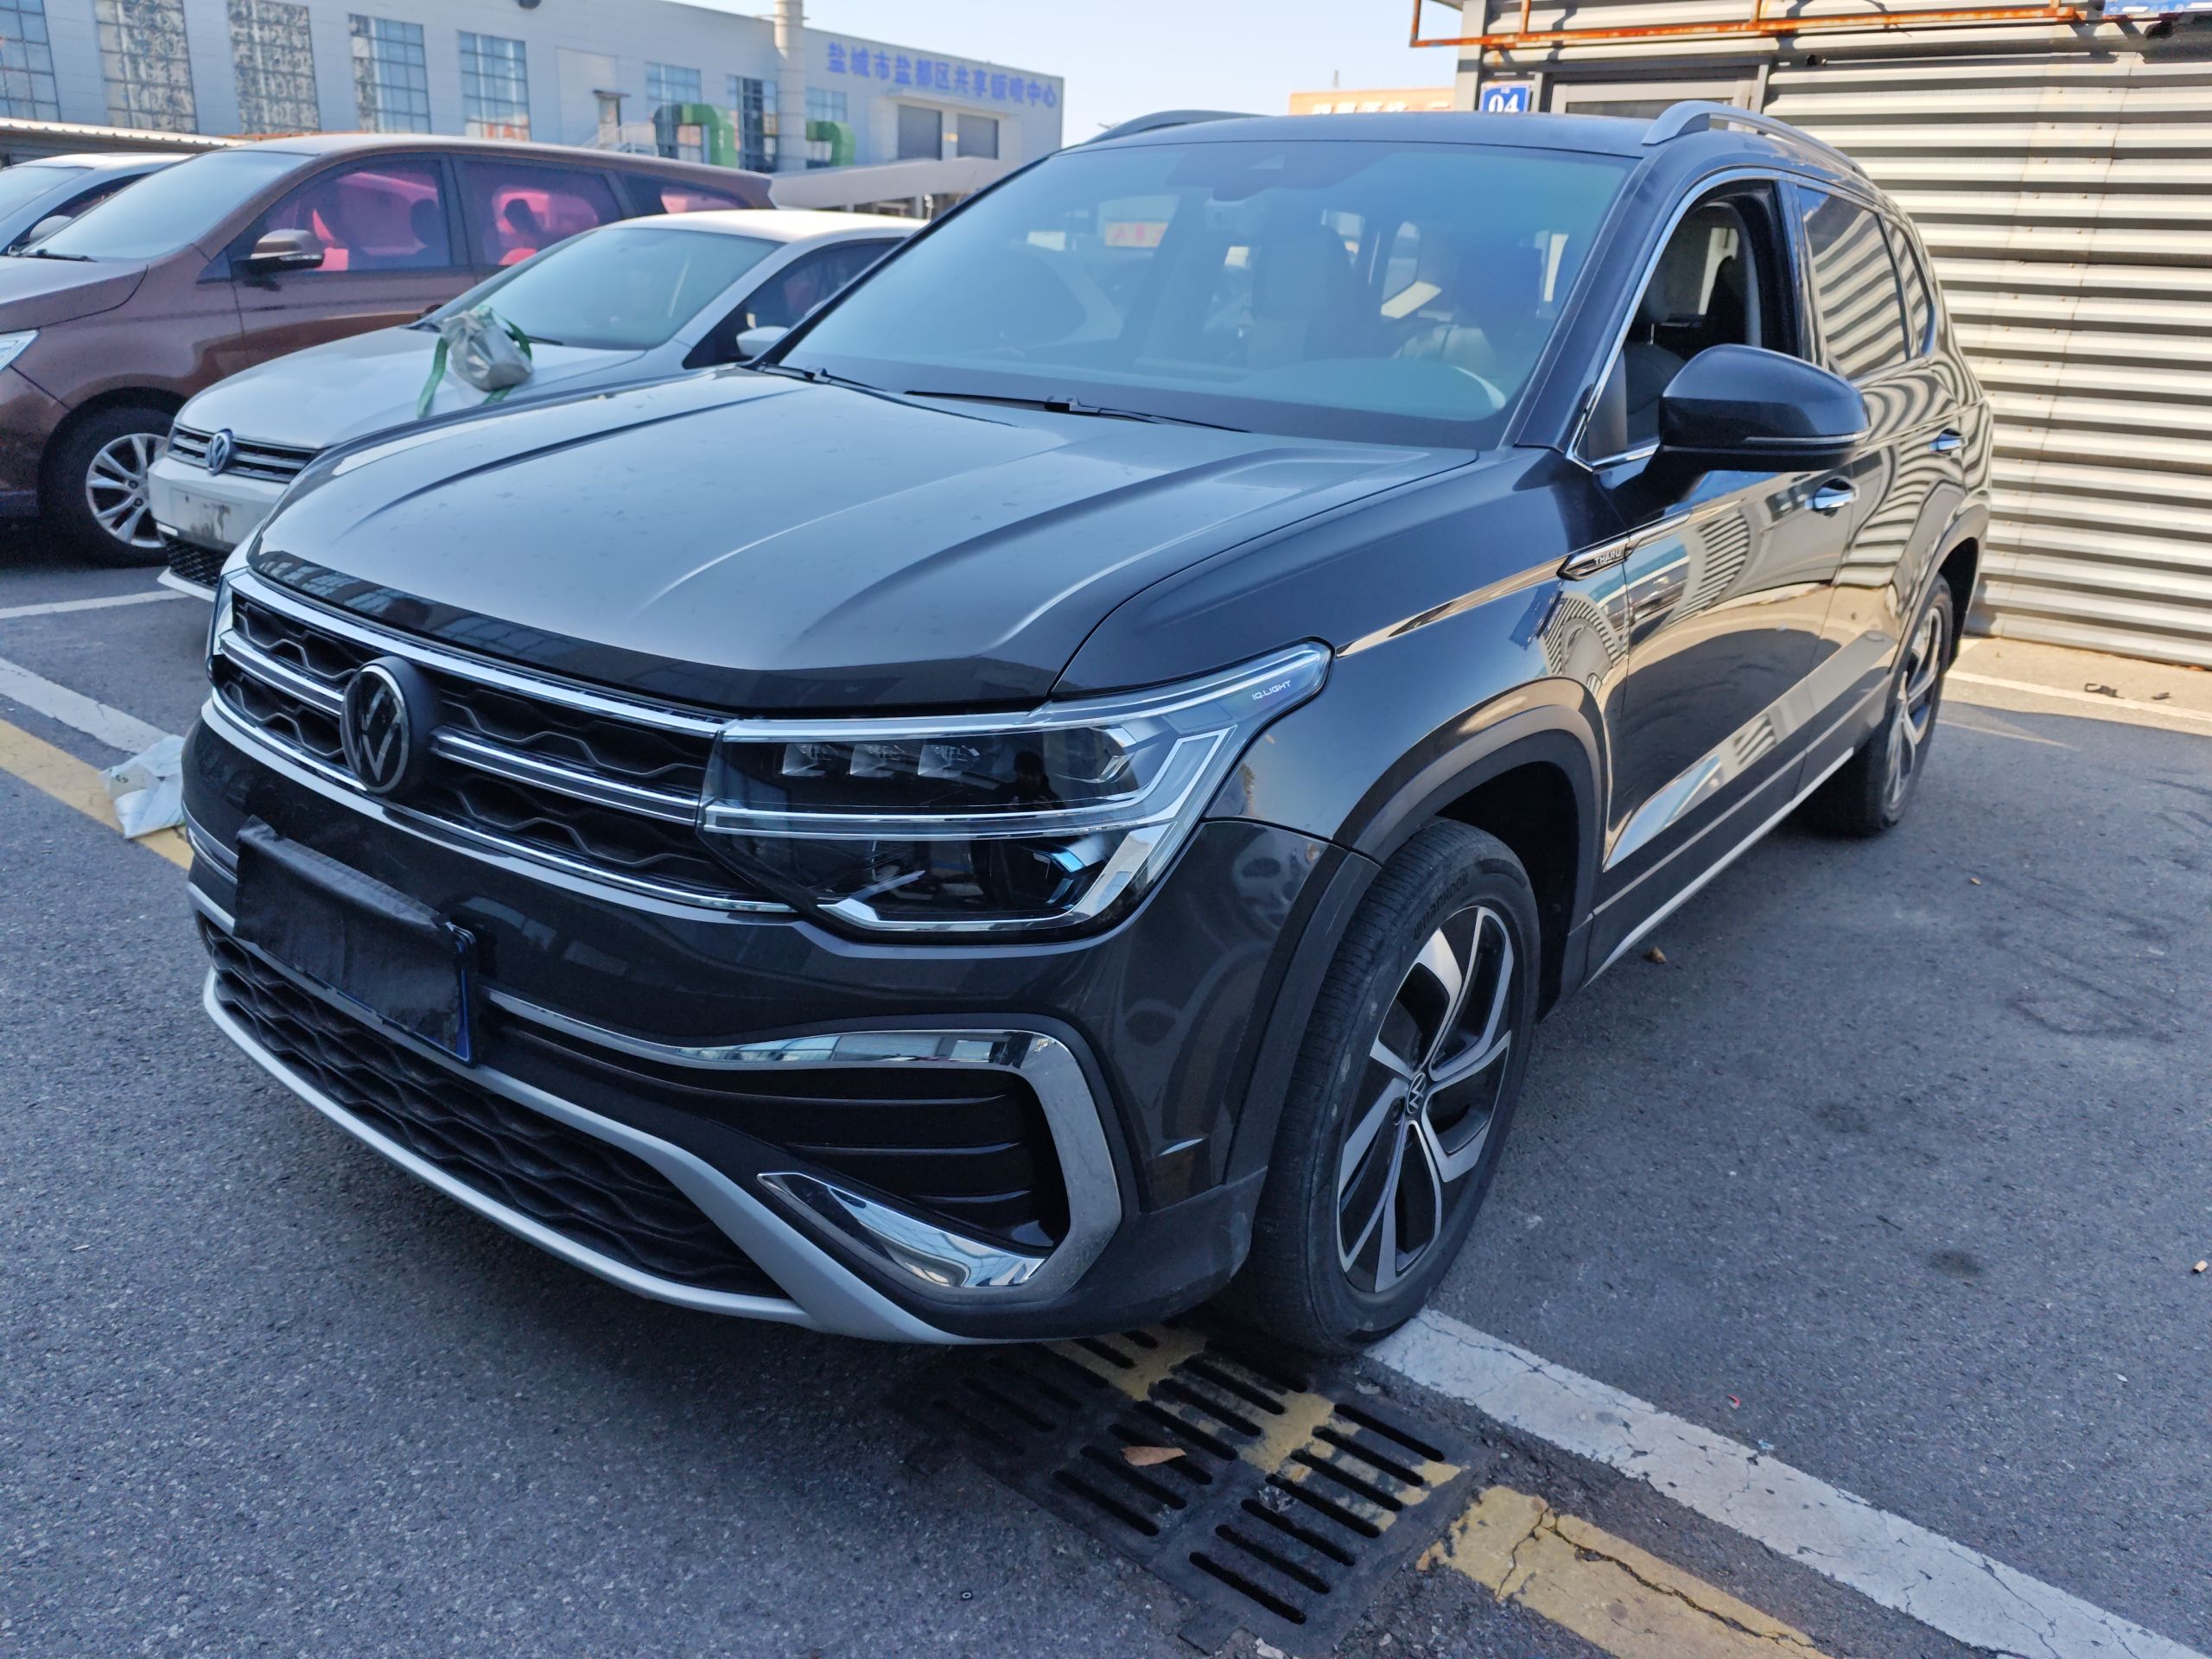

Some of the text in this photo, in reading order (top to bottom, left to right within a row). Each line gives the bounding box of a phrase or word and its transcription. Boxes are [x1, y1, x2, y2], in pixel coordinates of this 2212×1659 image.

[1488, 93, 1520, 112] 04
[1594, 550, 1622, 566] THARU
[1251, 679, 1291, 701] IQ.LIGHT
